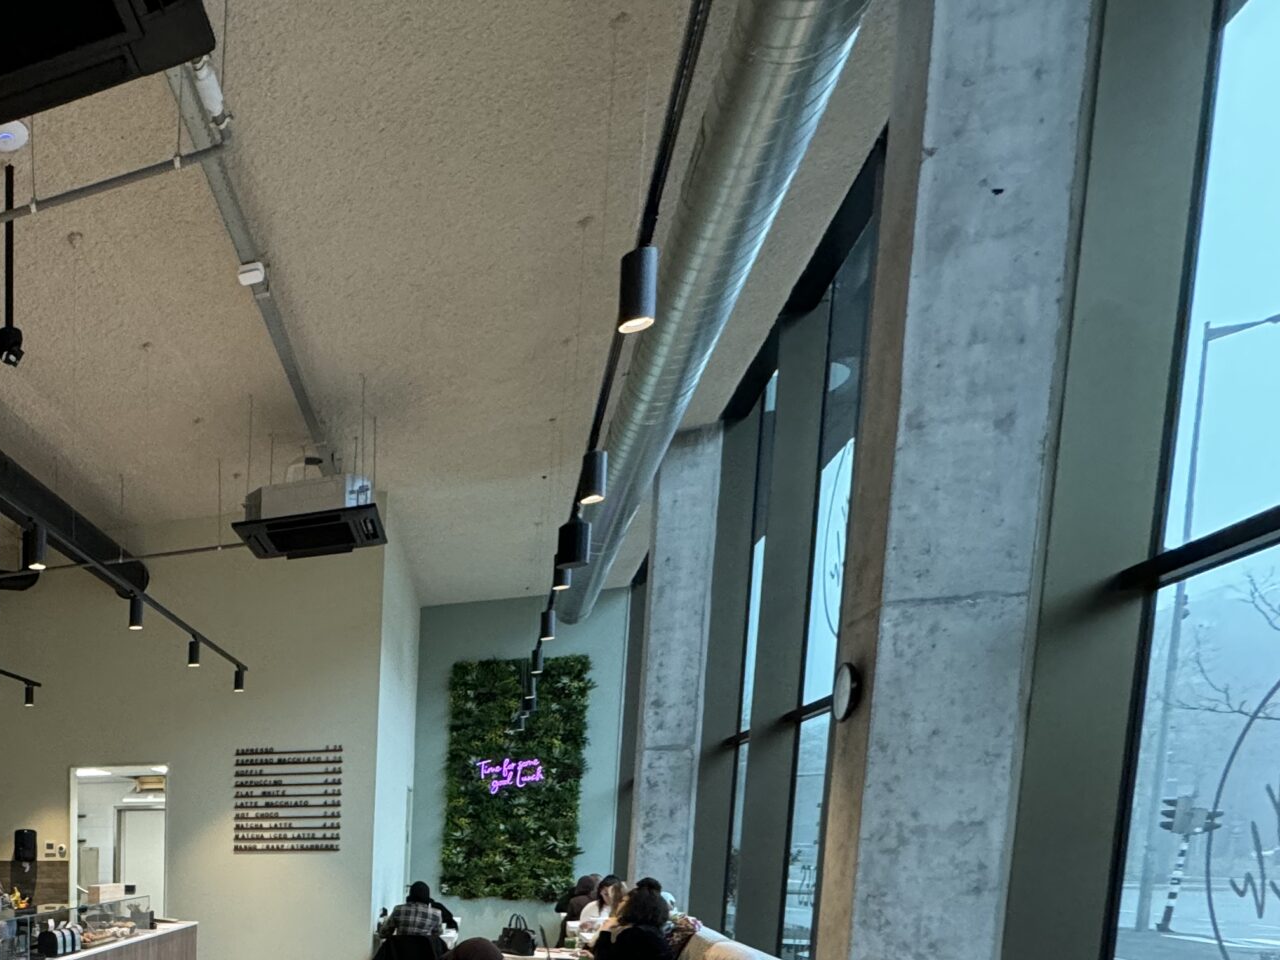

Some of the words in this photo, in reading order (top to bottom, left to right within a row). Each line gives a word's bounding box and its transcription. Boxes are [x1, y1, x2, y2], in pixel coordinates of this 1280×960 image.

[236, 757, 273, 765] ESPRESSO
[476, 760, 502, 779] Time
[502, 758, 516, 777] for
[490, 771, 513, 795] good
[264, 799, 308, 807] MACCHIATO
